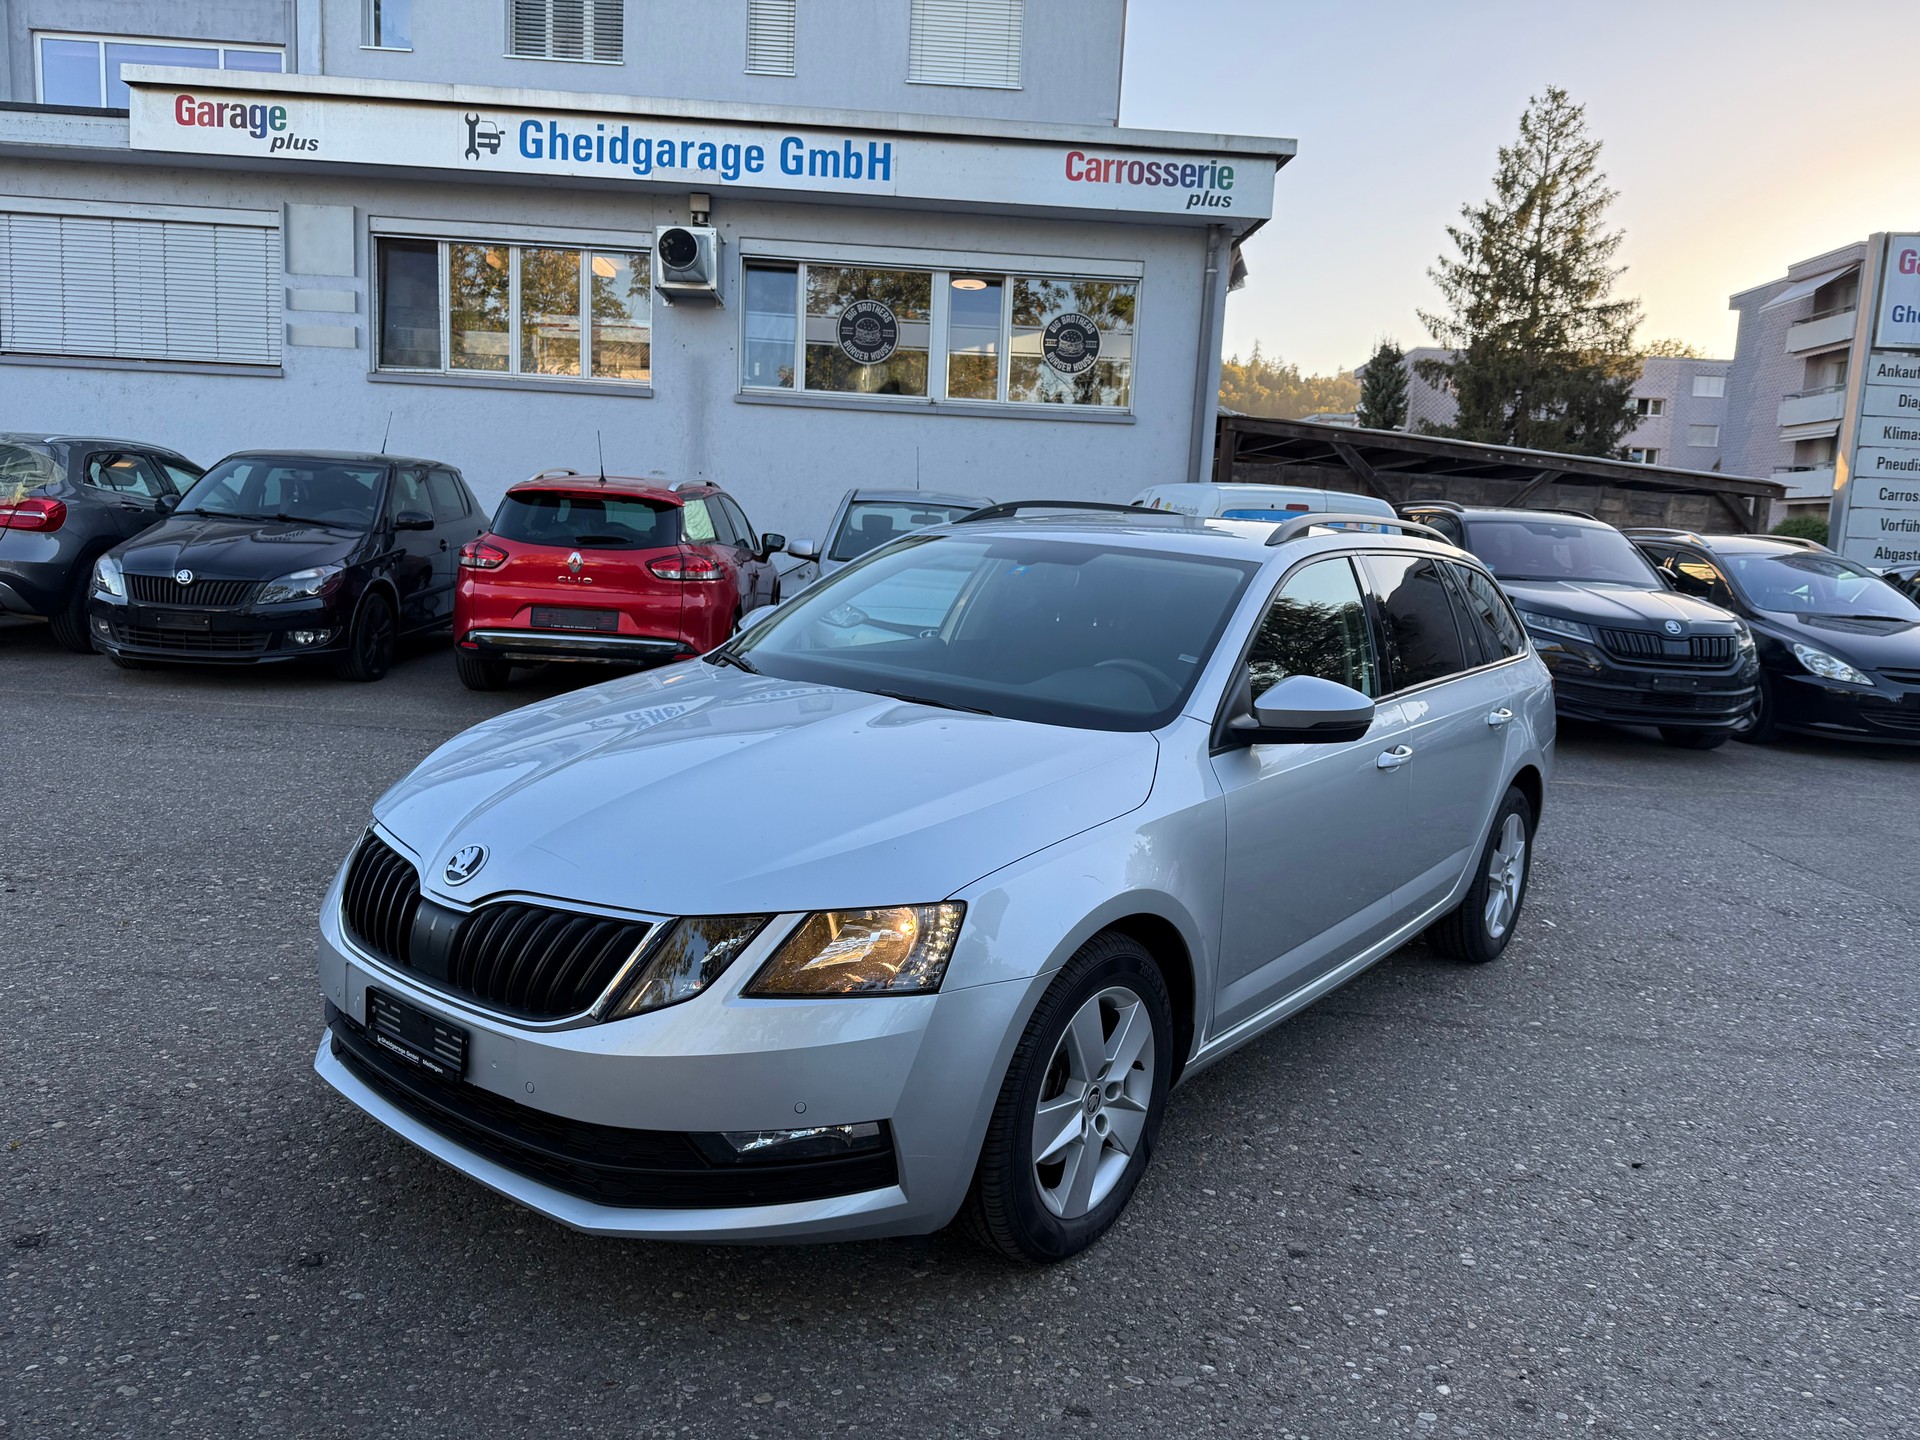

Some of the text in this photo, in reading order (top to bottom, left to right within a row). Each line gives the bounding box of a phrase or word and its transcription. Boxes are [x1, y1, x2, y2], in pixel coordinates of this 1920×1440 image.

[174, 94, 287, 139] Garage
[269, 133, 319, 153] plus
[518, 119, 892, 181] Gheidgarage GmbH
[1065, 151, 1234, 191] Carrosserie
[1185, 190, 1233, 209] plus
[1898, 248, 1920, 275] G
[844, 303, 893, 323] BIG BROTHERS
[1892, 304, 1920, 323] Gh
[1048, 314, 1096, 335] BIG BROTHERS
[843, 339, 893, 361] BURGER HOUSE
[1046, 351, 1095, 372] BURGER HOUSE
[1898, 394, 1920, 411] Dia
[1879, 487, 1920, 502] Carros
[557, 575, 593, 584] CLIO
[405, 1050, 420, 1061] GmbH
